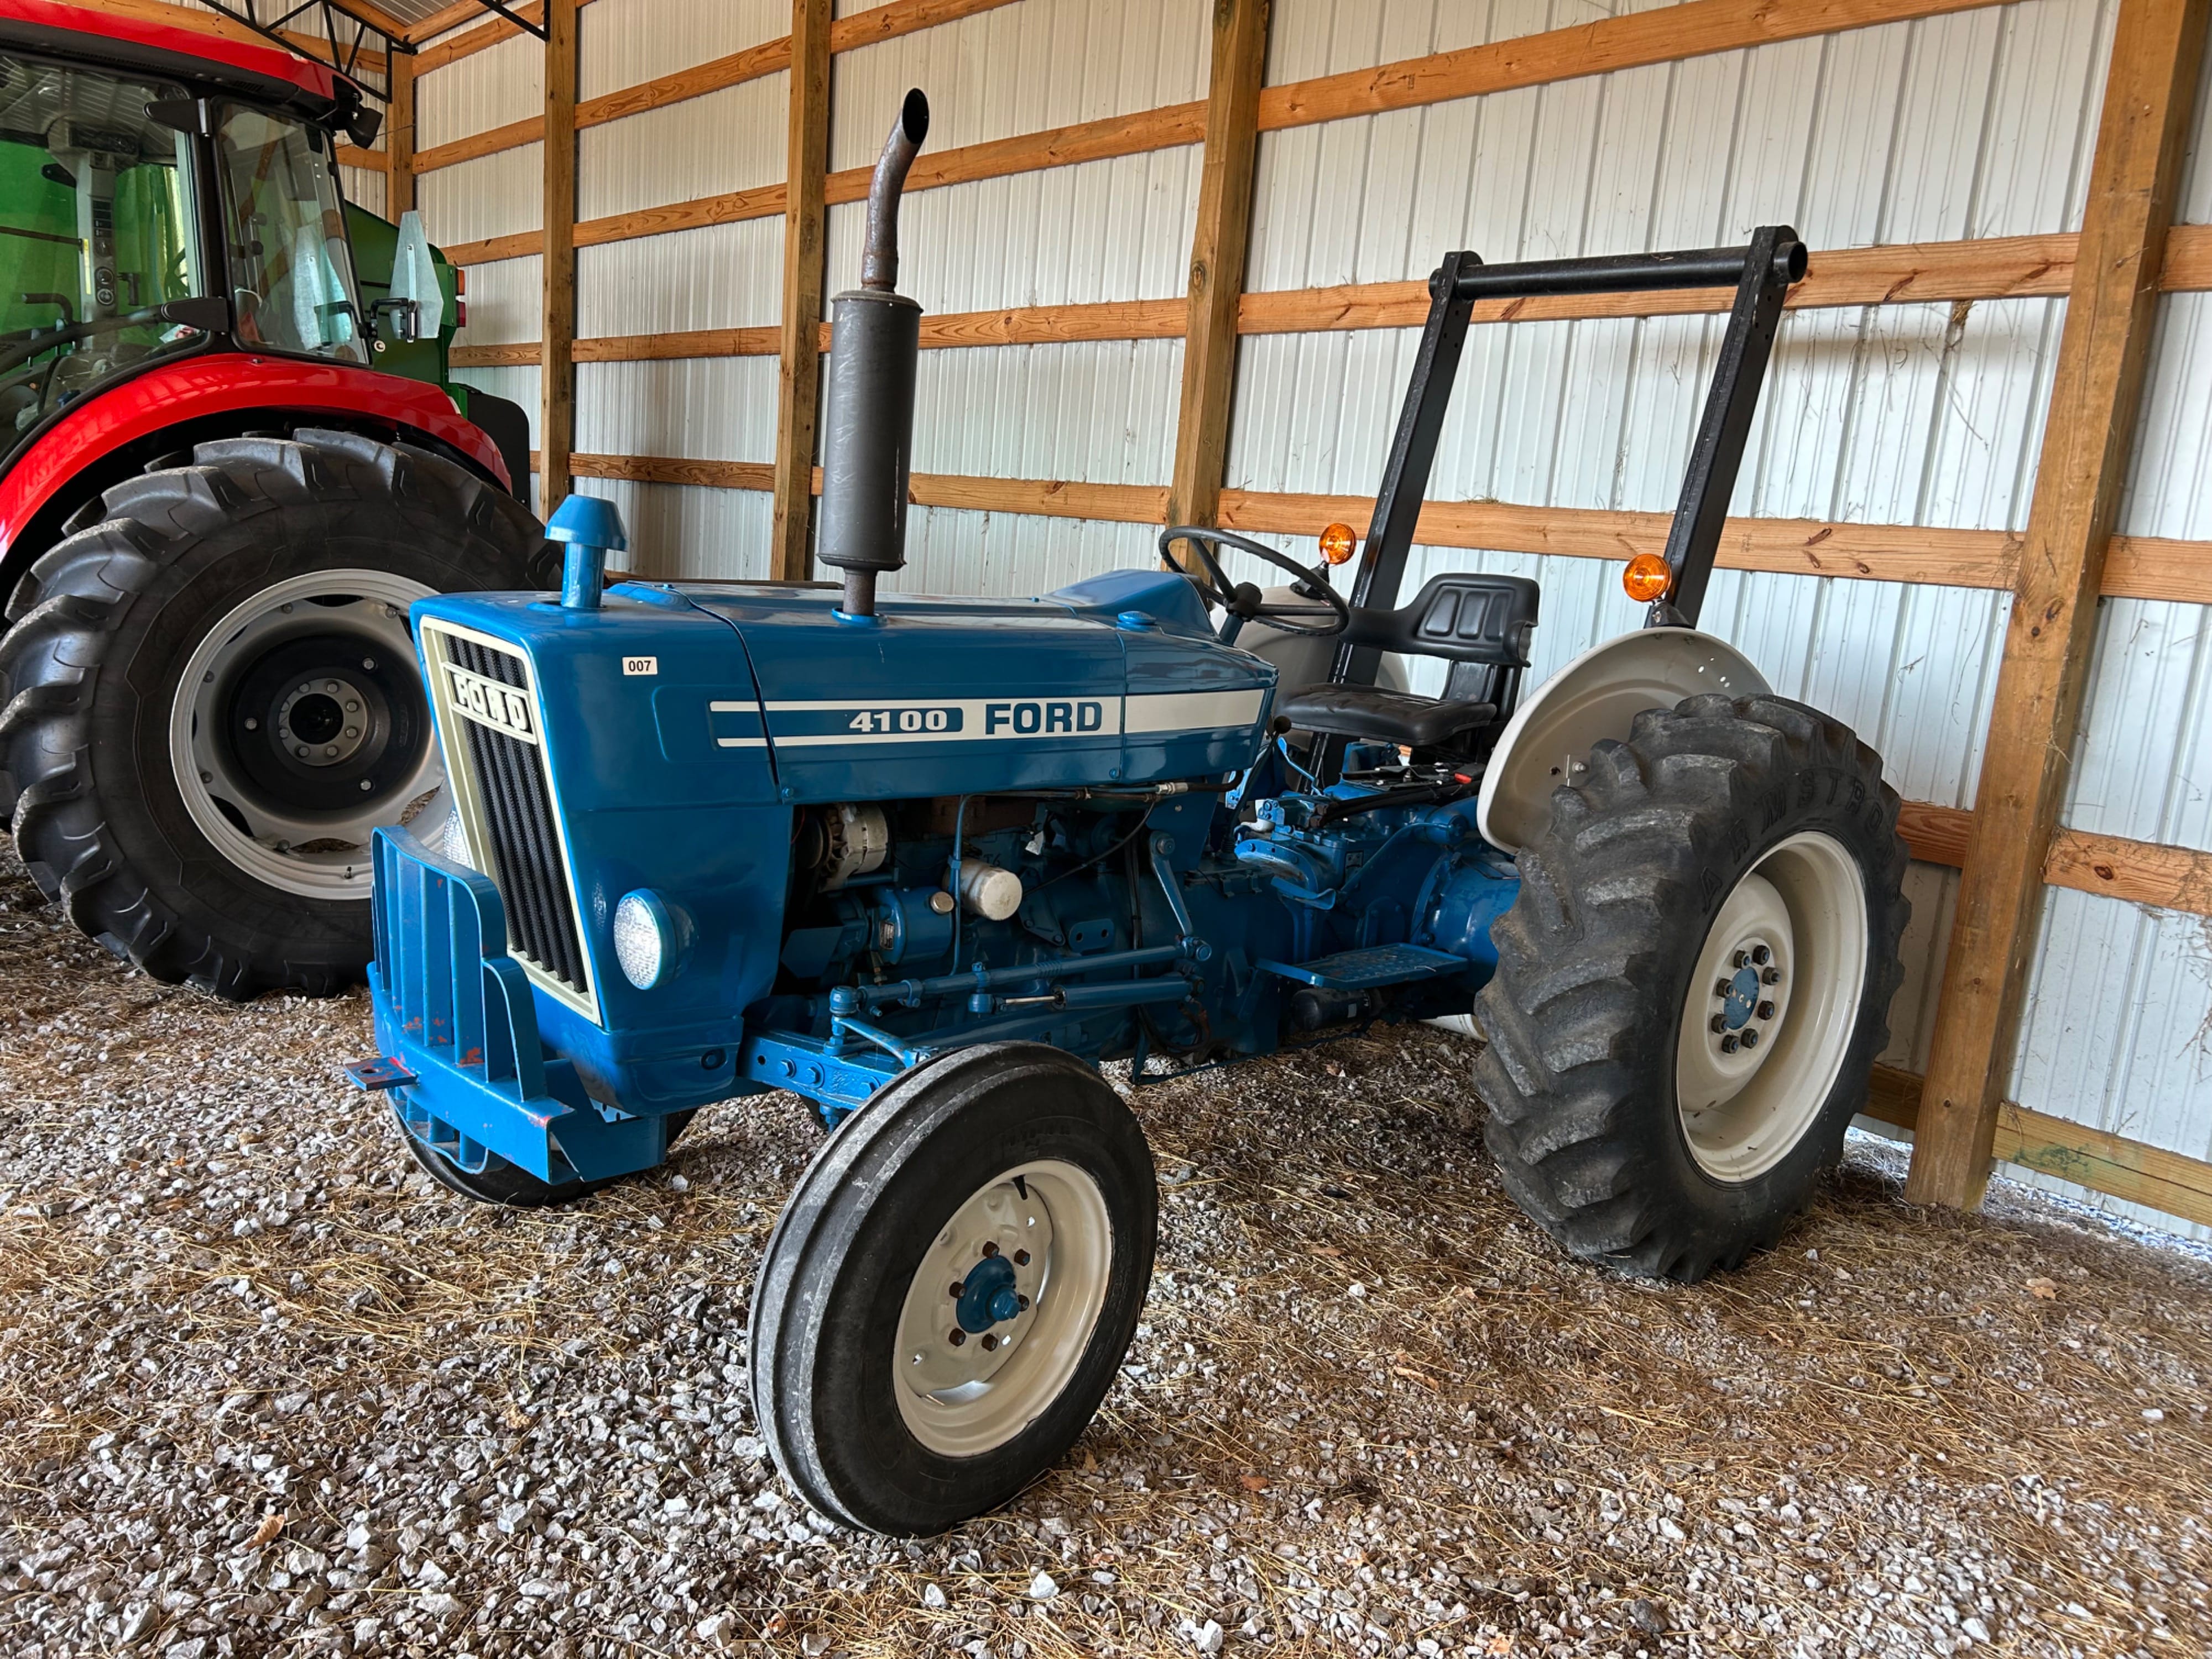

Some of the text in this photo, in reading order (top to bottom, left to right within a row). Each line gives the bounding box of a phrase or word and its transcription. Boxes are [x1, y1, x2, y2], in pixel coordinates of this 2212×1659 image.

[628, 660, 651, 672] 007
[453, 674, 528, 731] FORD
[849, 702, 1102, 735] 4100 FORD
